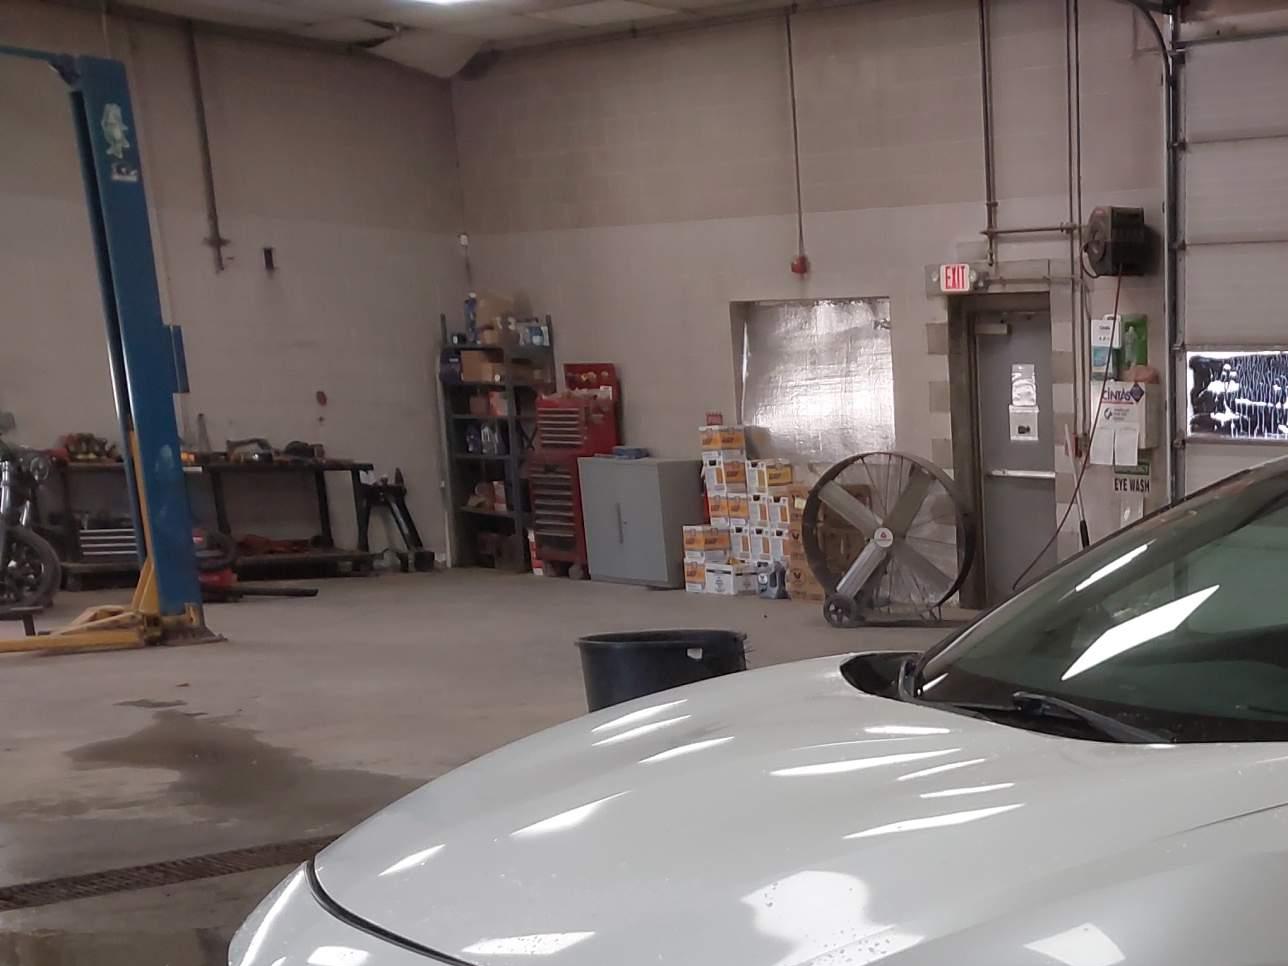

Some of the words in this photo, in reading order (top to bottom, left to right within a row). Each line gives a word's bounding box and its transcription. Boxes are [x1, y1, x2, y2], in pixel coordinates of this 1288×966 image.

[945, 265, 966, 289] EXIT
[1102, 386, 1131, 401] CINTAS
[1114, 478, 1128, 492] EYE
[1129, 479, 1150, 493] WASH
